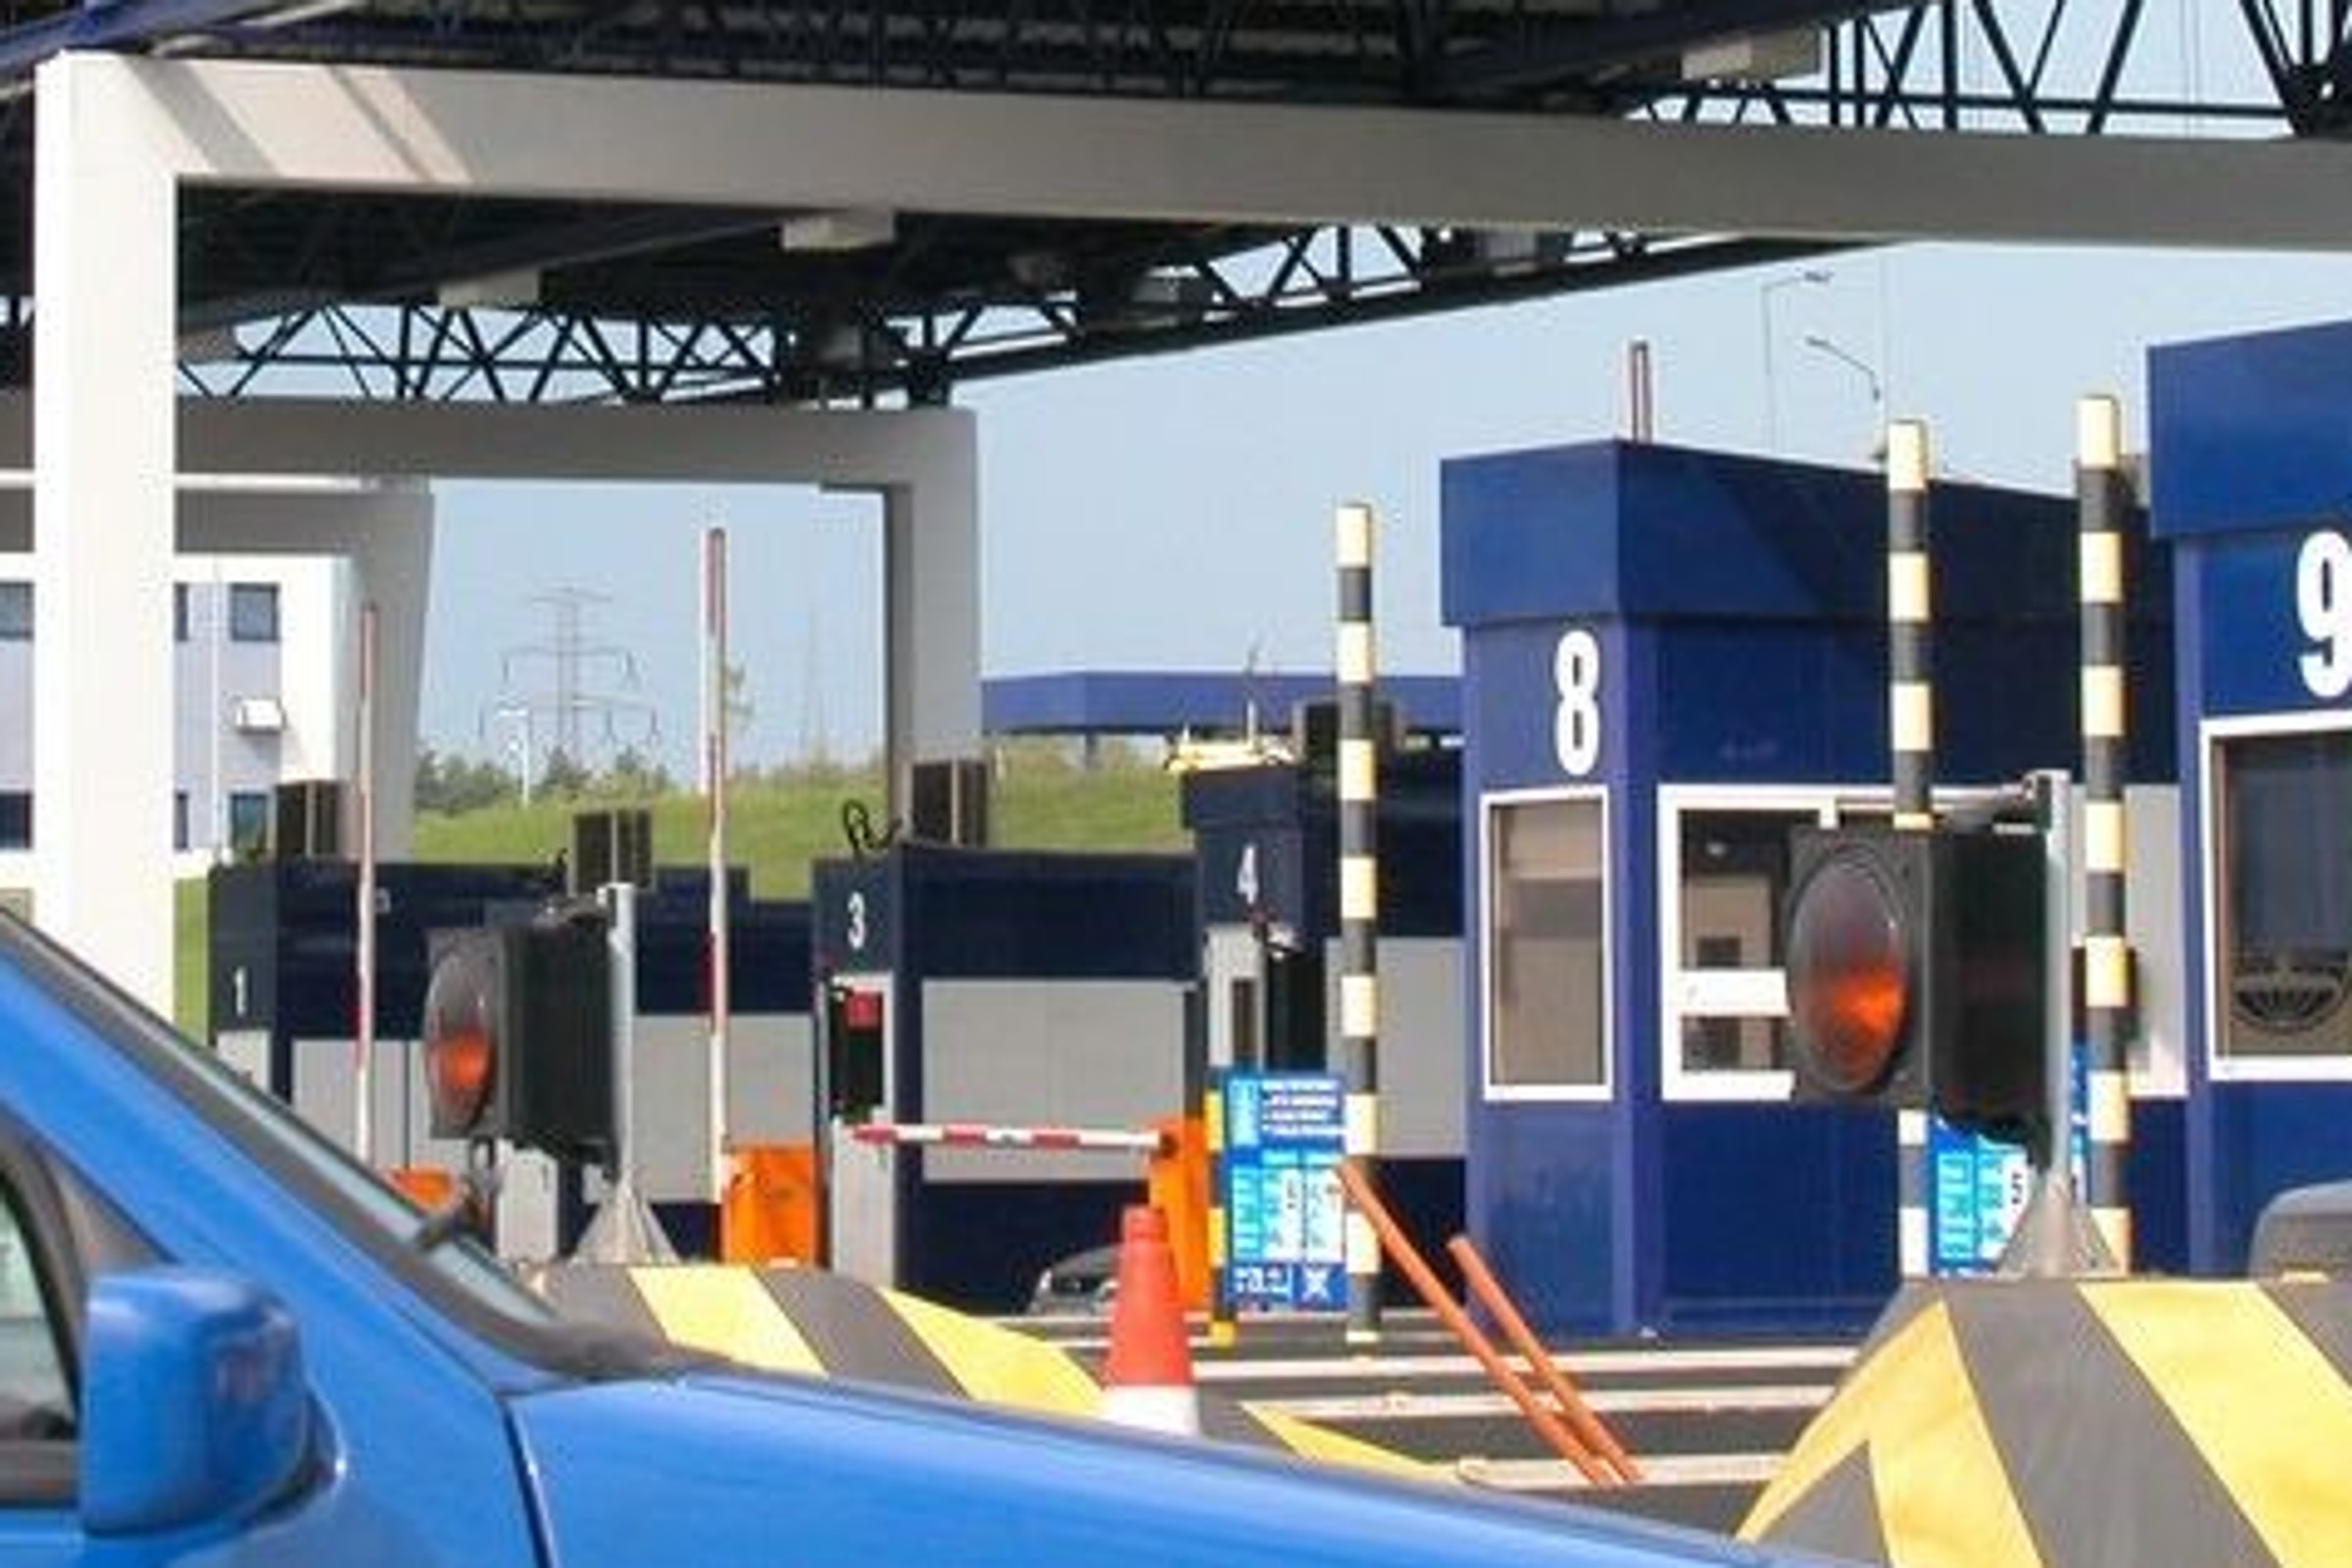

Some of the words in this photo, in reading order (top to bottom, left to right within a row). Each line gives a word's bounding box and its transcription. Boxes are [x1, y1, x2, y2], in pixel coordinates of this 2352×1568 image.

[2298, 531, 2352, 697] 9
[1555, 630, 1599, 775] 8
[1237, 847, 1258, 904] 4
[848, 892, 865, 949] 3
[233, 966, 247, 1015] 1
